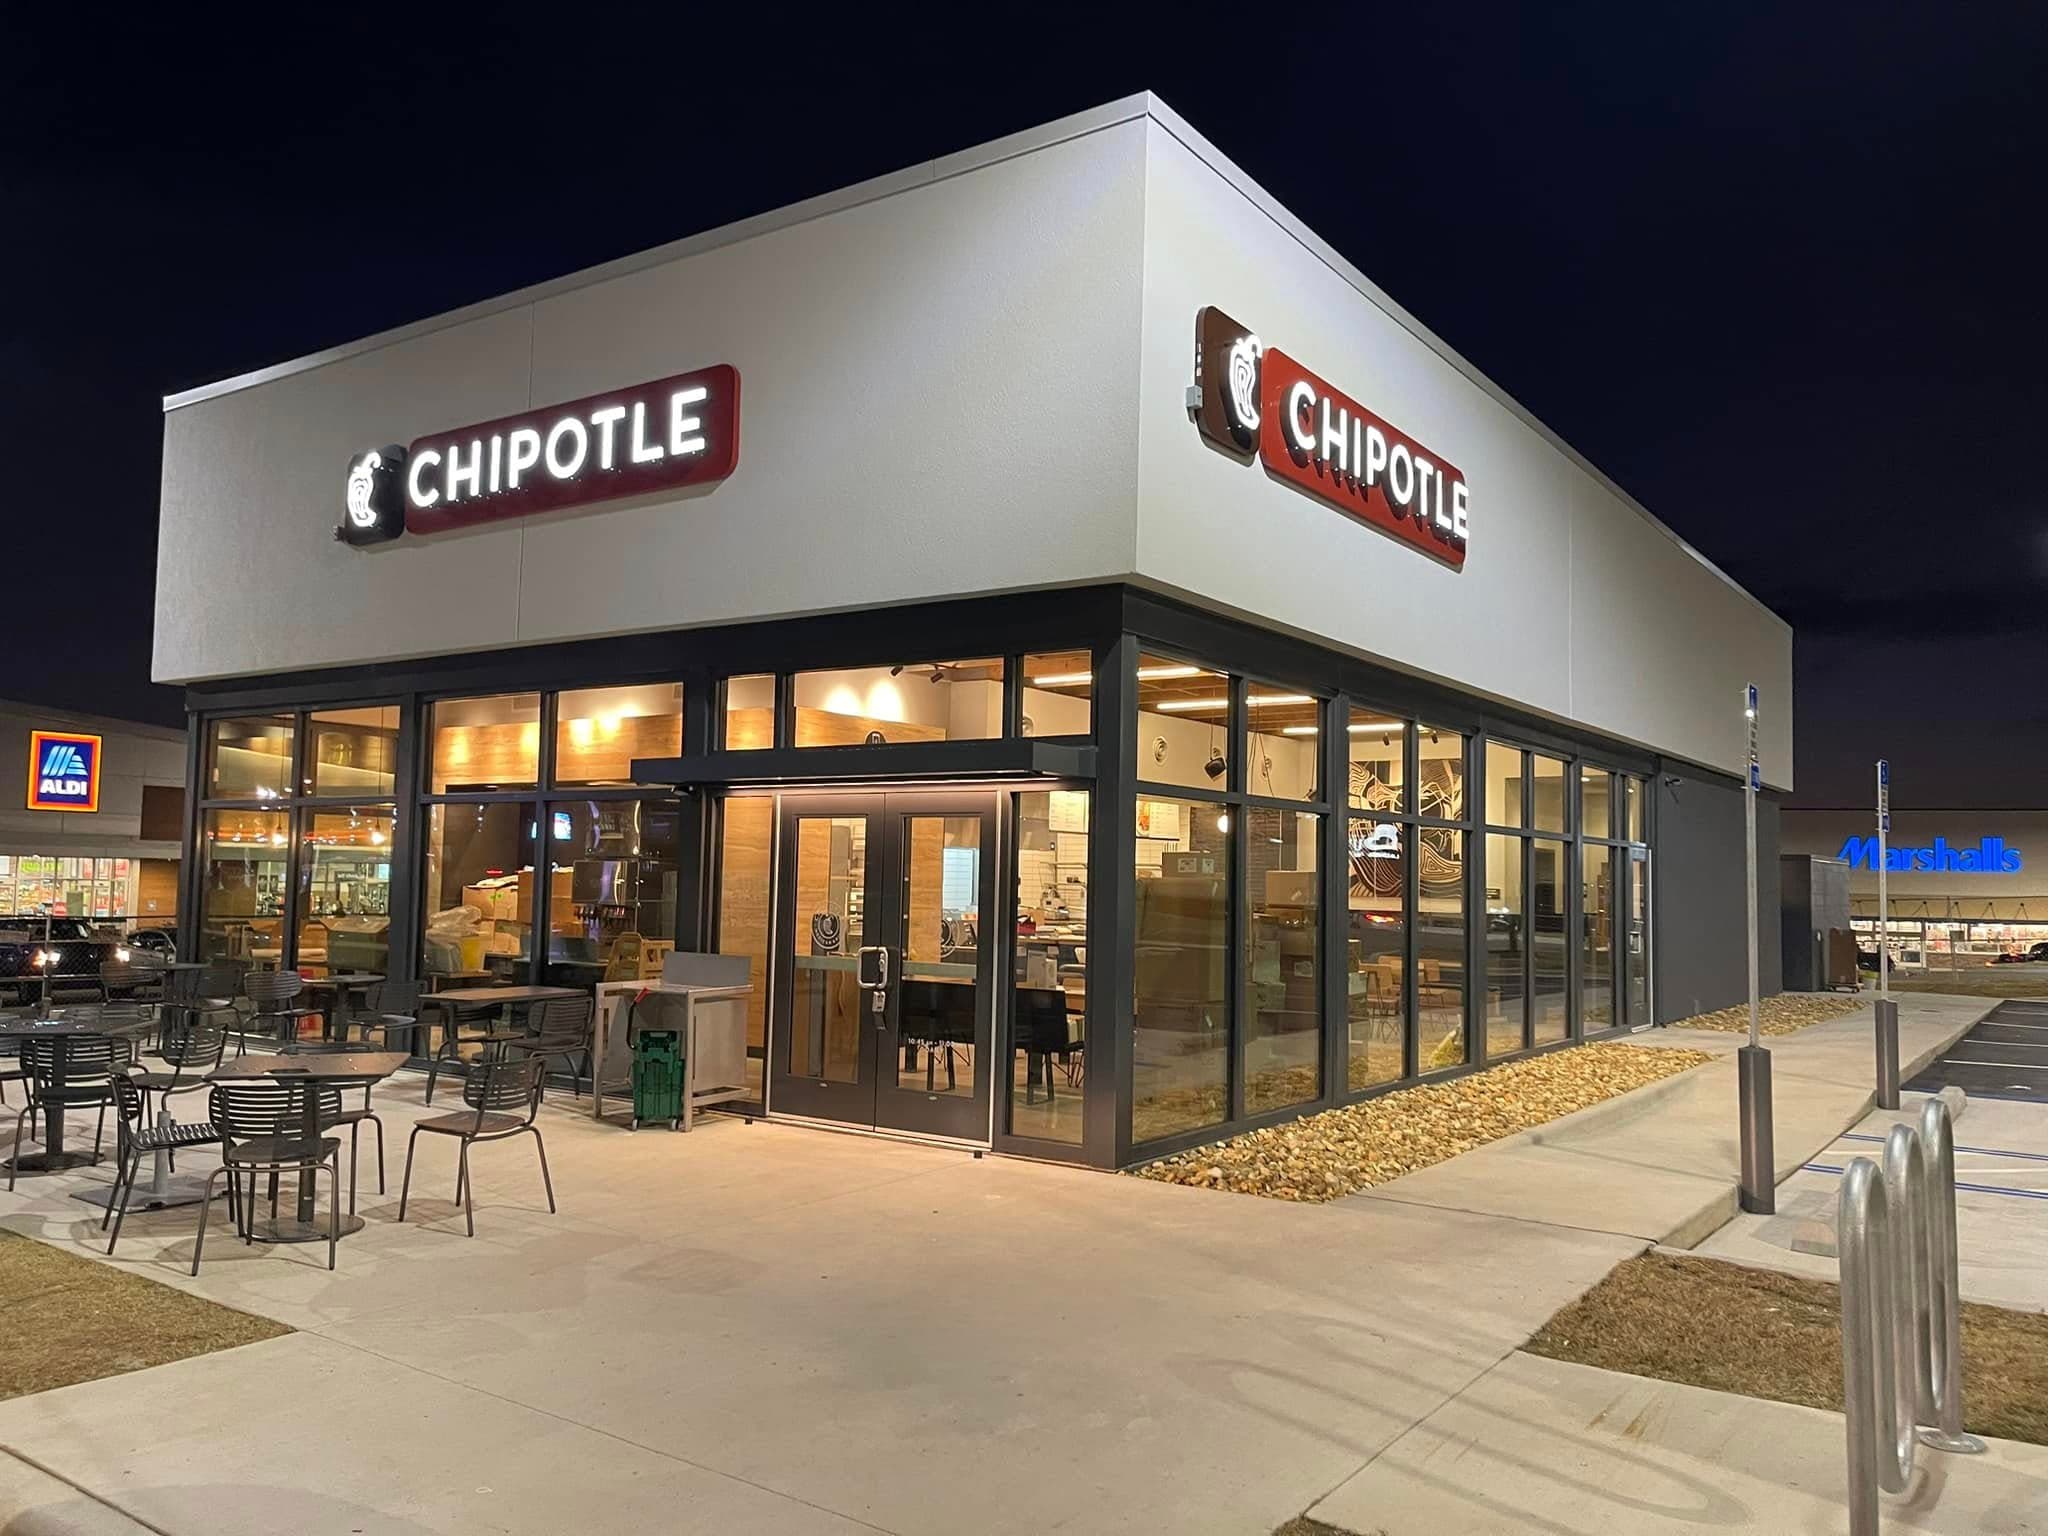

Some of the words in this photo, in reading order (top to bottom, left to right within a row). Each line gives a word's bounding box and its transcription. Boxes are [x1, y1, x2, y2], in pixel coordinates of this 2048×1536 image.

[407, 386, 708, 508] CHIPOTLE
[1289, 381, 1470, 541] CHIPOTLE
[40, 778, 88, 796] ALDI
[1837, 834, 2024, 874] Marshalls
